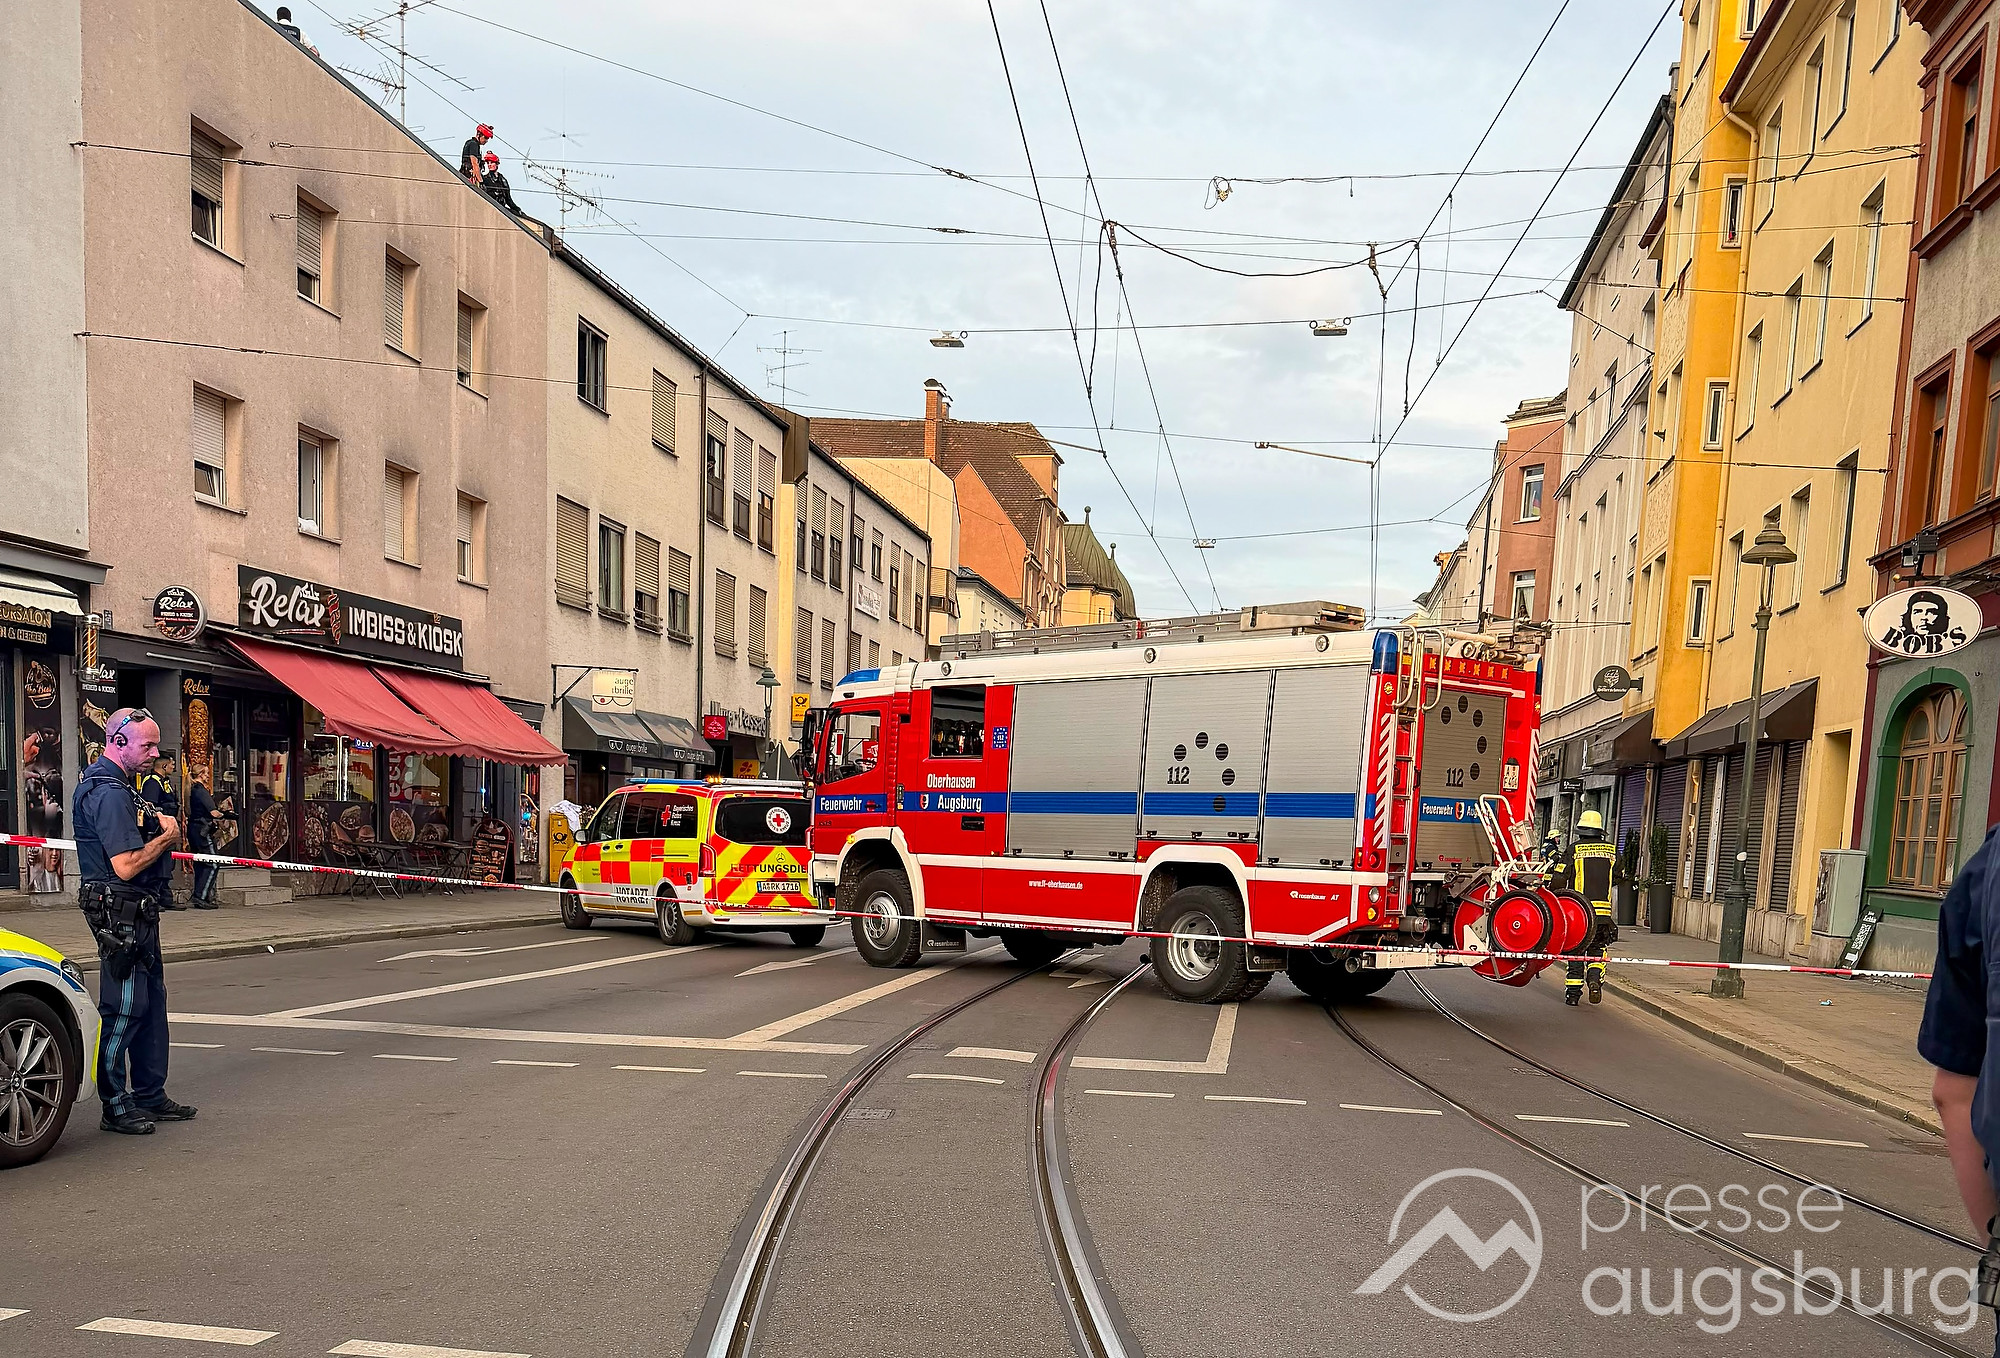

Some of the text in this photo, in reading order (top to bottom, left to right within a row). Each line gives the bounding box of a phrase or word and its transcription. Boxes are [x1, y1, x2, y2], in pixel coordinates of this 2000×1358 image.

[158, 596, 194, 610] Relax
[249, 576, 325, 628] Relax
[17, 629, 47, 644] HERREN
[349, 606, 405, 645] IMBISS
[418, 624, 464, 658] KIOSK
[1881, 626, 1967, 653] BOB'S
[183, 678, 210, 695] Relax
[927, 773, 976, 789] Oberhausen
[1166, 766, 1190, 785] 112
[1446, 767, 1464, 788] 112
[820, 797, 863, 811] Feuerwehr
[938, 795, 982, 813] Augsburg
[1422, 803, 1453, 815] Feuerwehr
